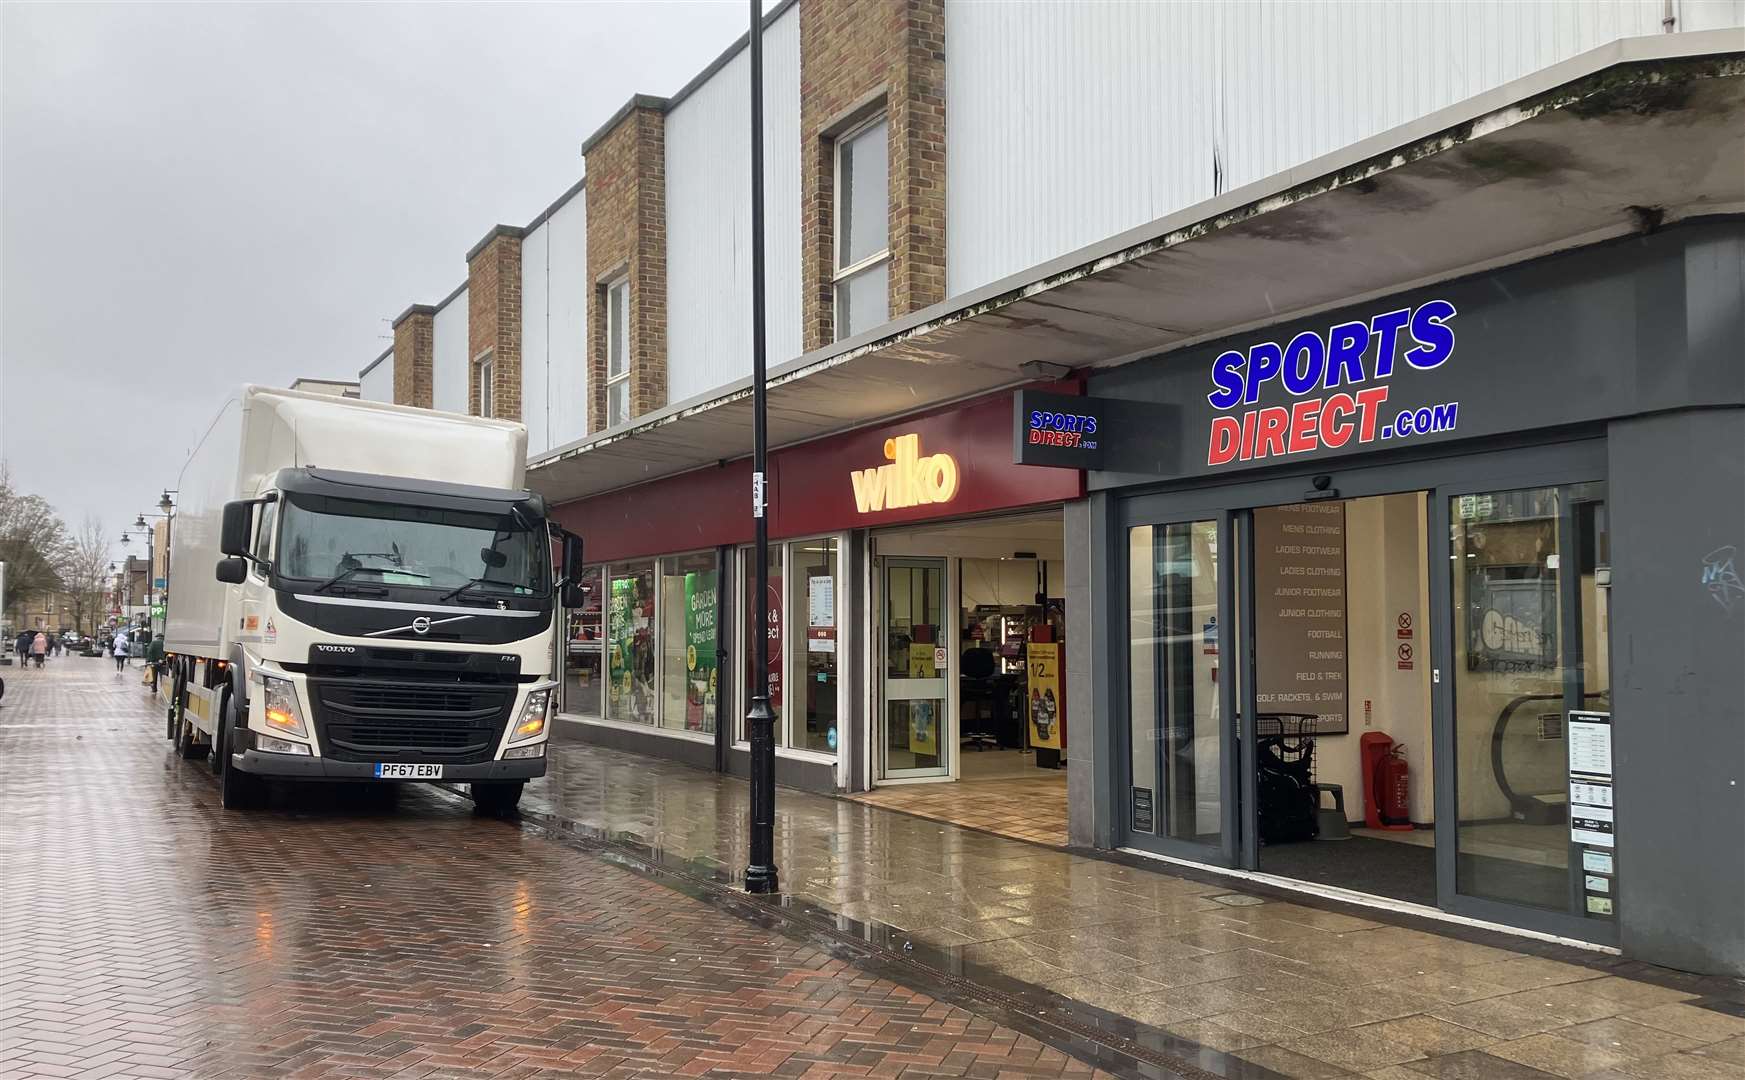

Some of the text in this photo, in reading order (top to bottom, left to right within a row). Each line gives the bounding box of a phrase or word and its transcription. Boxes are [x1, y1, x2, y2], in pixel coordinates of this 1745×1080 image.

[1207, 299, 1457, 411] SPORTS
[1030, 410, 1097, 434] SPORTS
[850, 433, 959, 514] wilko
[1281, 524, 1341, 535] MENS CLOTHING
[1275, 545, 1341, 555] LADIES FOOTWEAR
[1280, 566, 1341, 576] LADIES CLOTHING
[1274, 587, 1341, 597] JUNIOR FOOTWEAR
[691, 587, 717, 611] GARDEN
[1279, 609, 1342, 618] JUNIOR CLOTHING
[695, 609, 713, 629] MORE
[1307, 630, 1343, 639] FOOTBALL
[317, 644, 356, 654] VOLVO
[1309, 651, 1343, 660] RUNNING
[1296, 672, 1316, 681] FIELD
[1325, 671, 1342, 680] TREK
[1322, 691, 1343, 701] SWIM
[383, 764, 441, 777] PF67 EBV
